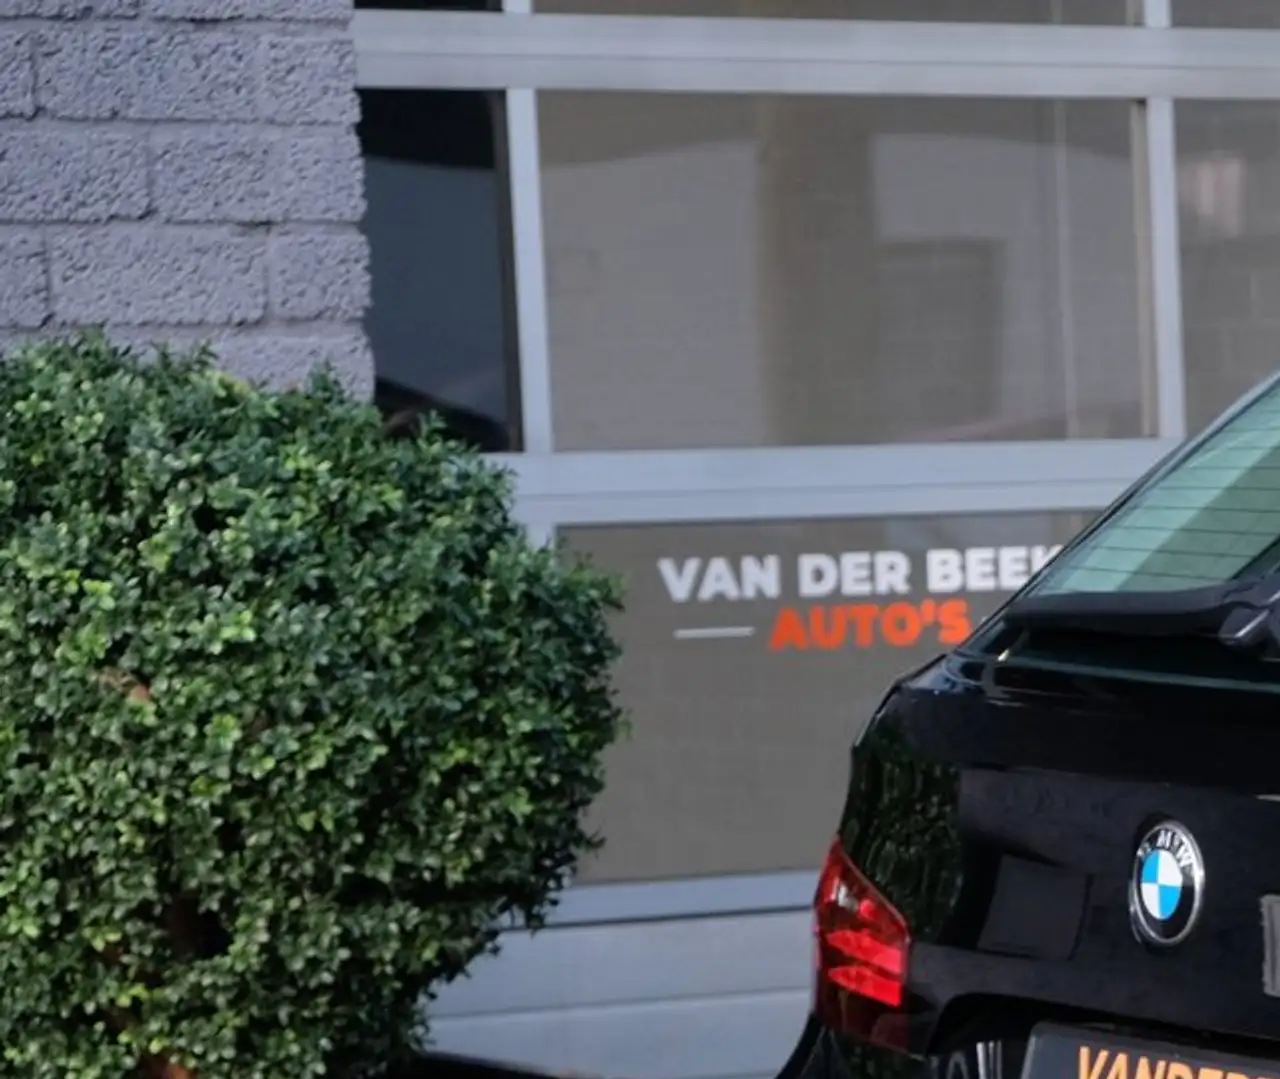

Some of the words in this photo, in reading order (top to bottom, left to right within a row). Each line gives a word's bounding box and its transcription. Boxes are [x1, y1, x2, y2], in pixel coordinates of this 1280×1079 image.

[658, 555, 780, 602] VAN
[798, 550, 910, 597] DER
[769, 600, 972, 652] AUTO'S
